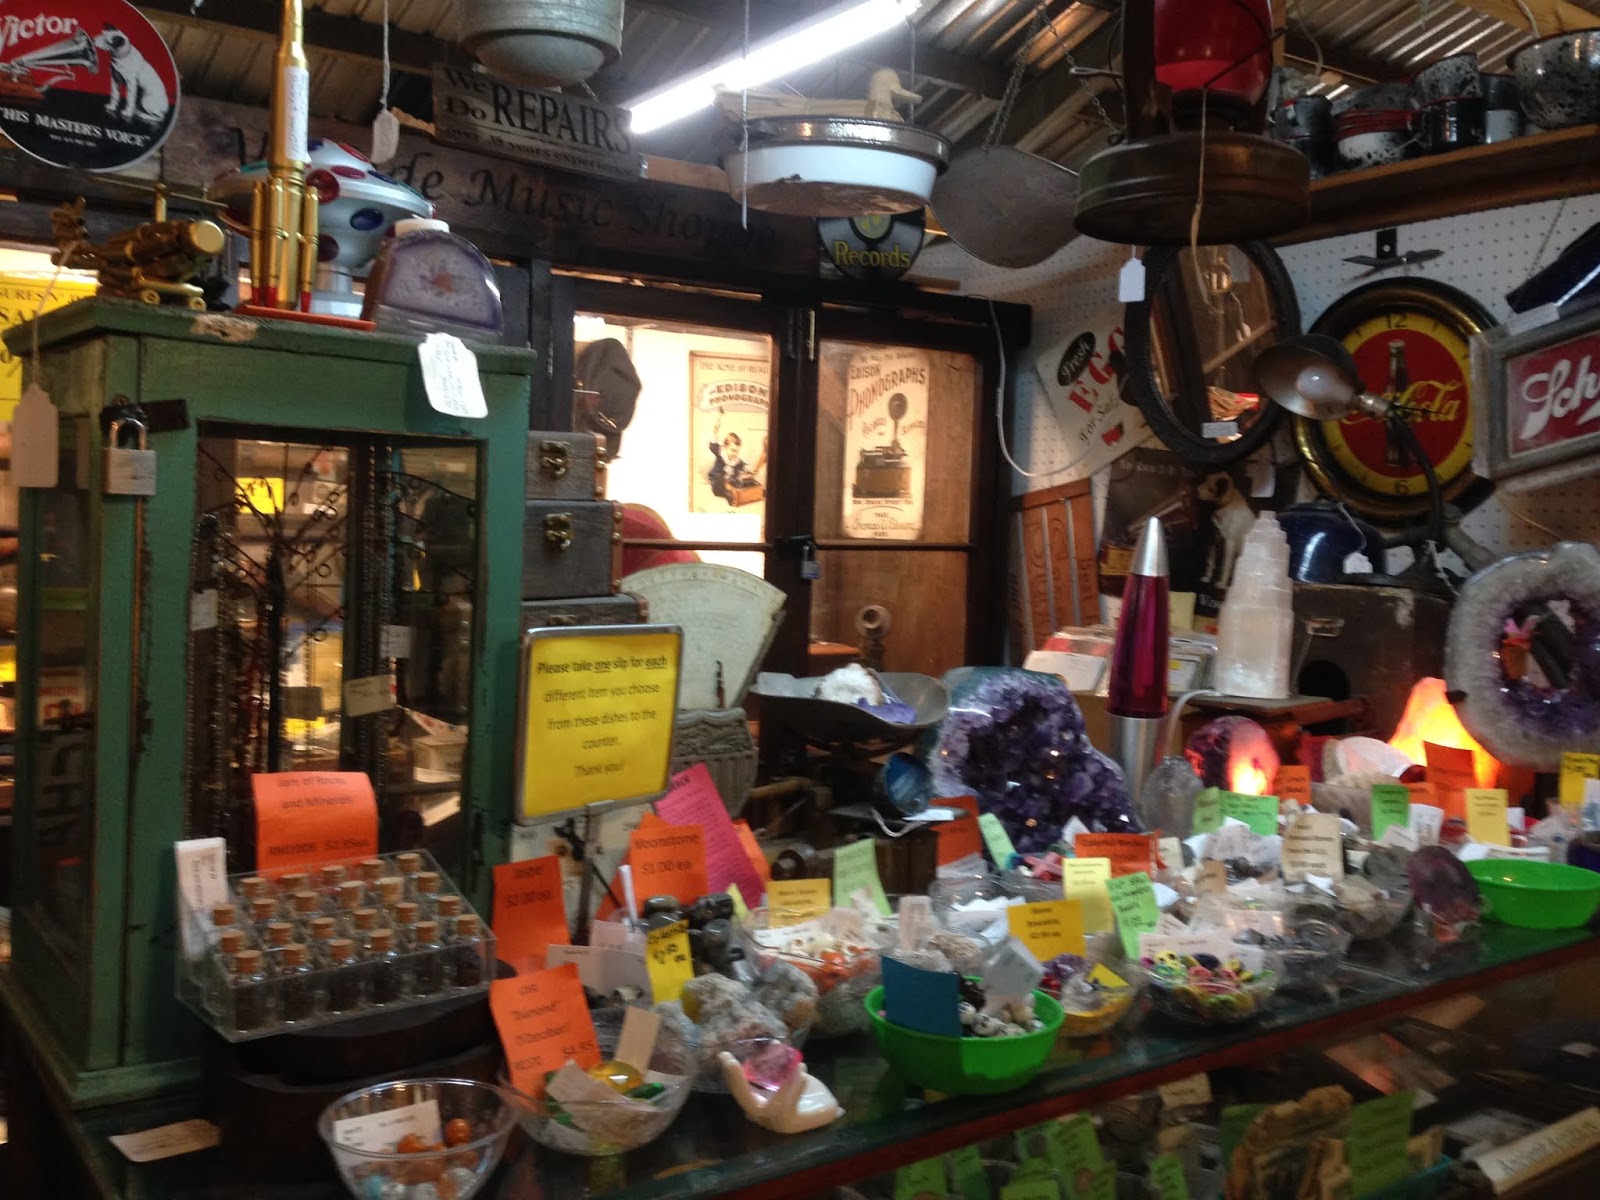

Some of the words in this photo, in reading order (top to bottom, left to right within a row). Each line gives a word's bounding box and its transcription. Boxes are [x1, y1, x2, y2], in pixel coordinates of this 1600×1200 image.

[444, 68, 487, 93] We
[446, 96, 487, 120] Do
[491, 84, 631, 153] REPAIRS
[464, 168, 615, 226] Music
[833, 240, 912, 268] Records
[1386, 314, 1408, 328] 12
[850, 364, 881, 380] EDISON
[716, 383, 769, 397] EDISON
[846, 367, 926, 430] PHONOGRAPHS
[537, 660, 570, 674] Please
[572, 659, 593, 672] take
[594, 660, 611, 672] one
[614, 657, 628, 671] slip
[630, 656, 643, 668] for
[644, 655, 668, 669] each
[544, 688, 586, 702] different
[627, 683, 660, 695] choose
[547, 718, 574, 730] from
[641, 708, 657, 720] the
[575, 763, 600, 777] Thank
